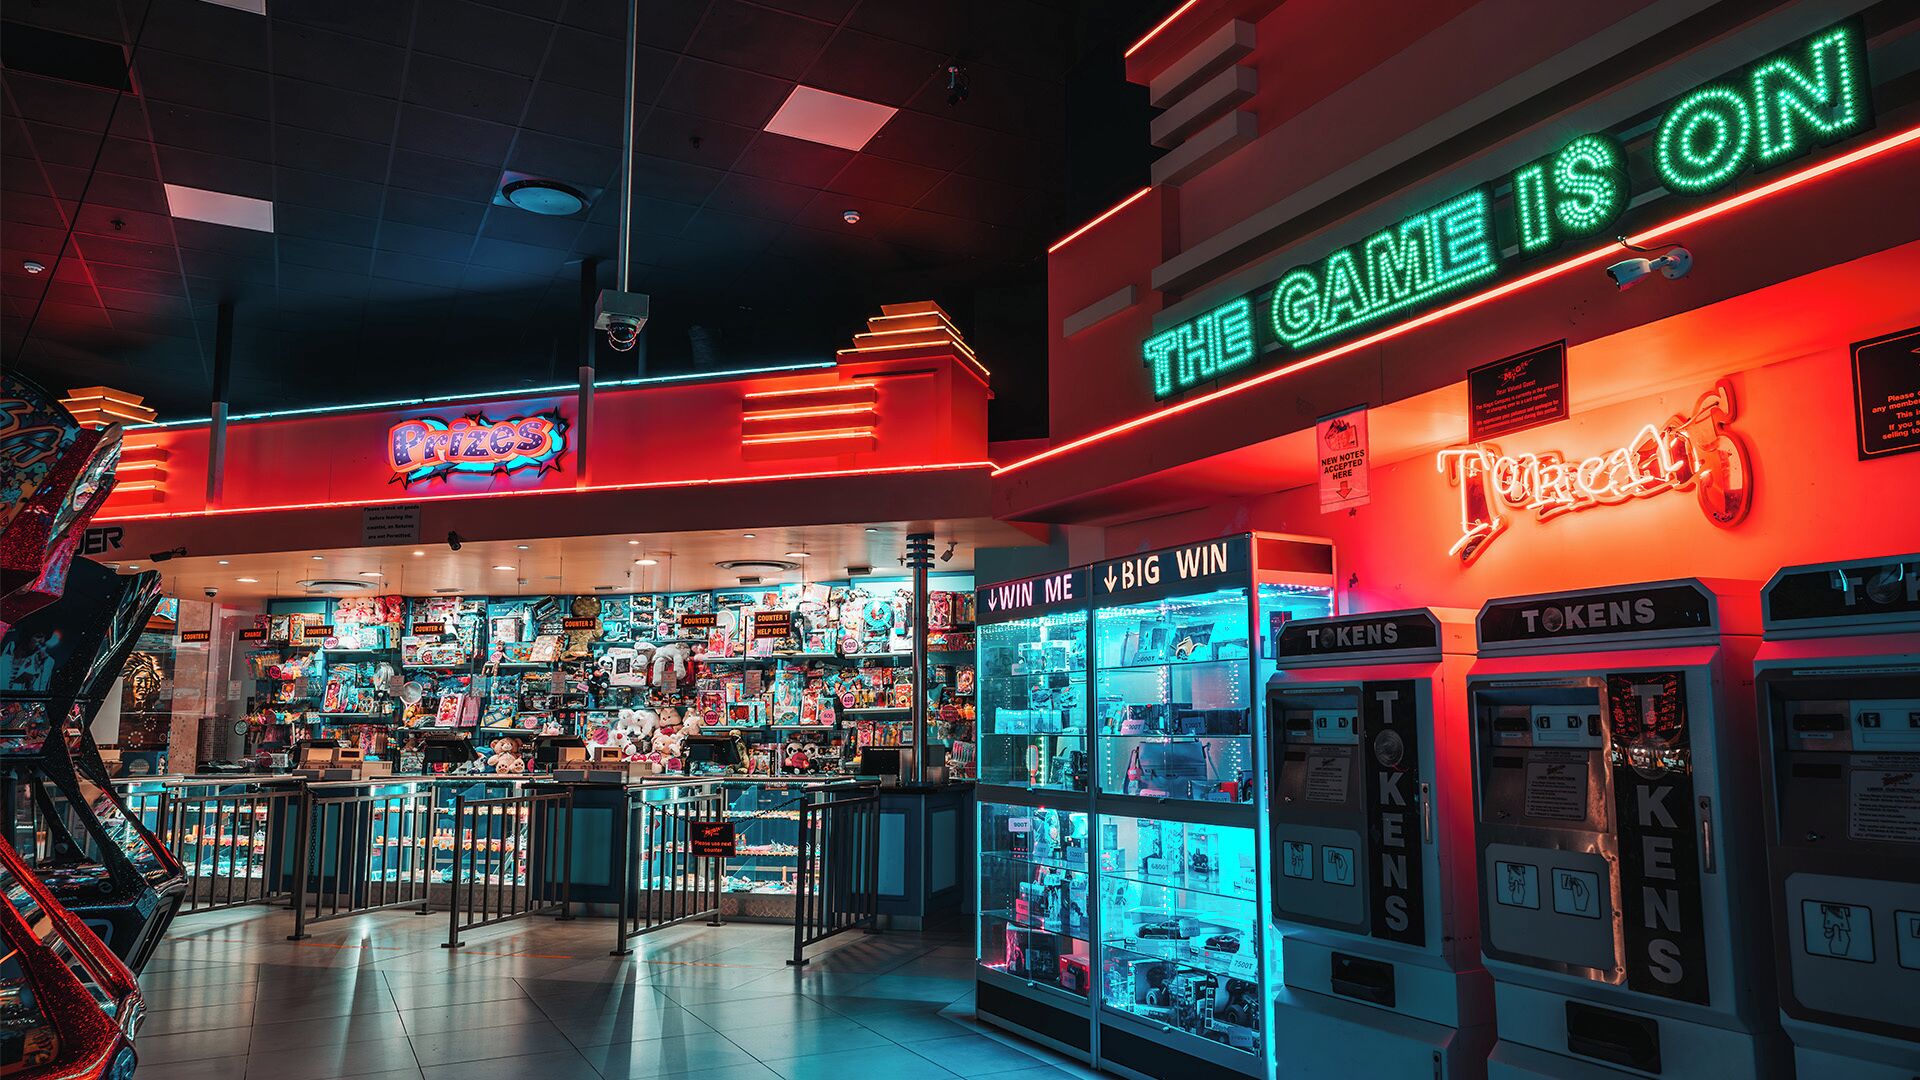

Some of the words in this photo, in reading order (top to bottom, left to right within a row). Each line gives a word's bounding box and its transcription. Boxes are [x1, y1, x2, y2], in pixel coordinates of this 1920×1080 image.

[1145, 296, 1253, 396] THE
[1272, 188, 1491, 346] GAME
[1517, 134, 1616, 251] IS
[1656, 29, 1858, 190] ON
[1888, 392, 1914, 403] Please
[1872, 405, 1886, 413] any
[1896, 411, 1913, 420] This
[1898, 420, 1913, 431] you
[1882, 429, 1909, 440] selling
[389, 416, 553, 471] Prizes
[1321, 456, 1338, 466] NEW
[1339, 450, 1365, 462] NOTES
[1324, 458, 1363, 474] ACCEPTED
[1332, 469, 1352, 480] HERE
[1121, 555, 1160, 590] BIG
[1176, 542, 1228, 579] WIN
[999, 582, 1033, 611] WIN
[1045, 573, 1073, 604] ME
[683, 617, 709, 625] COUNTER
[757, 614, 783, 622] COUNTER
[1519, 598, 1657, 633] TOKENS
[565, 620, 588, 628] COUNTER
[772, 627, 787, 635] DESK
[1306, 622, 1399, 650] TOKENS
[1373, 690, 1409, 932] TOKENS
[1628, 683, 1684, 985] TOKENS
